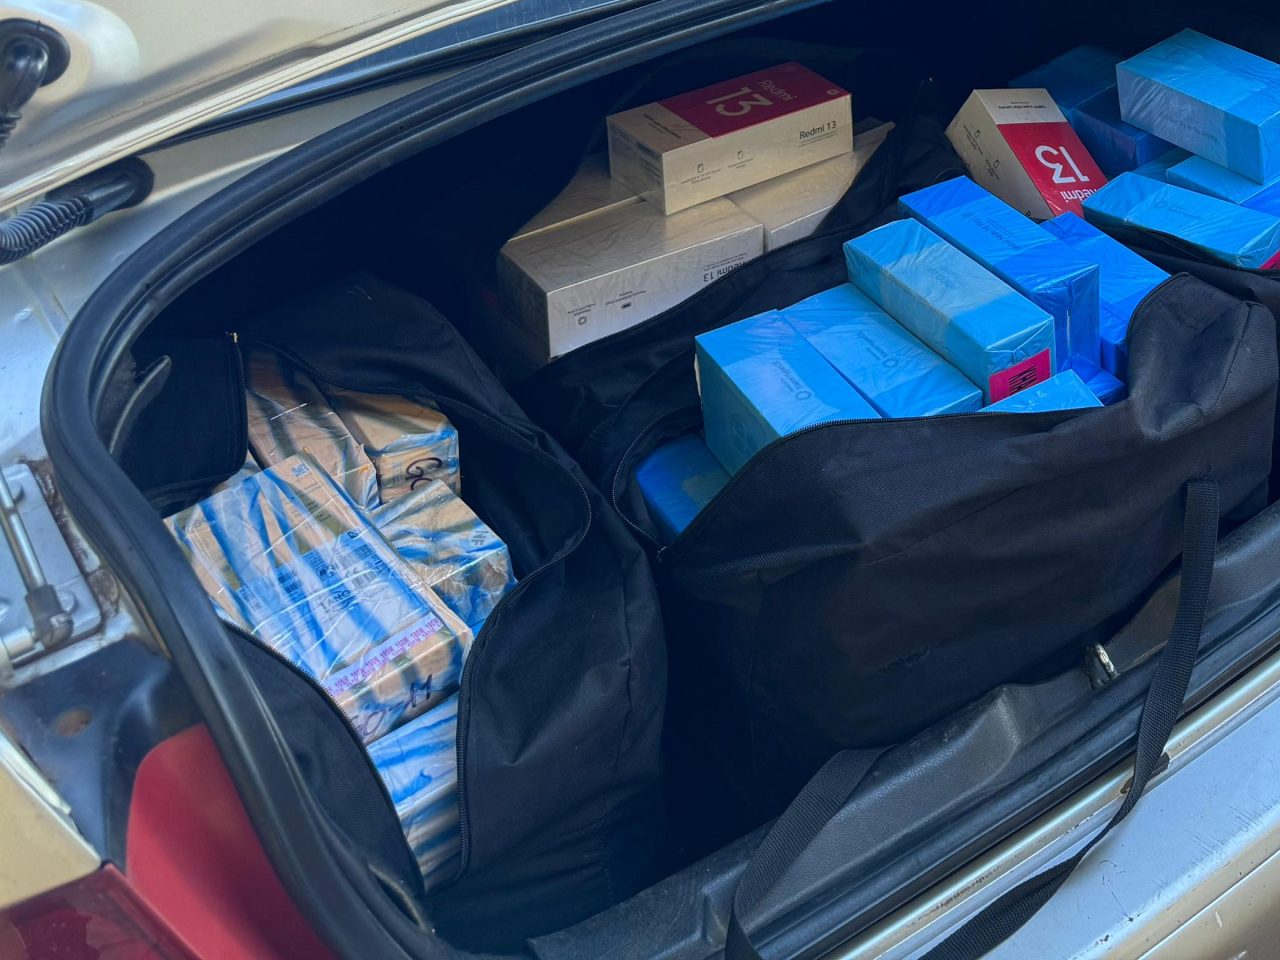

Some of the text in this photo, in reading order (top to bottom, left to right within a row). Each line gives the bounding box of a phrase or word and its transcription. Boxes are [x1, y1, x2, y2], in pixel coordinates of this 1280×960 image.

[706, 86, 774, 117] 13
[757, 79, 798, 102] Redmi
[799, 126, 825, 140] Redmi
[827, 120, 837, 130] 13
[1034, 145, 1090, 184] 13
